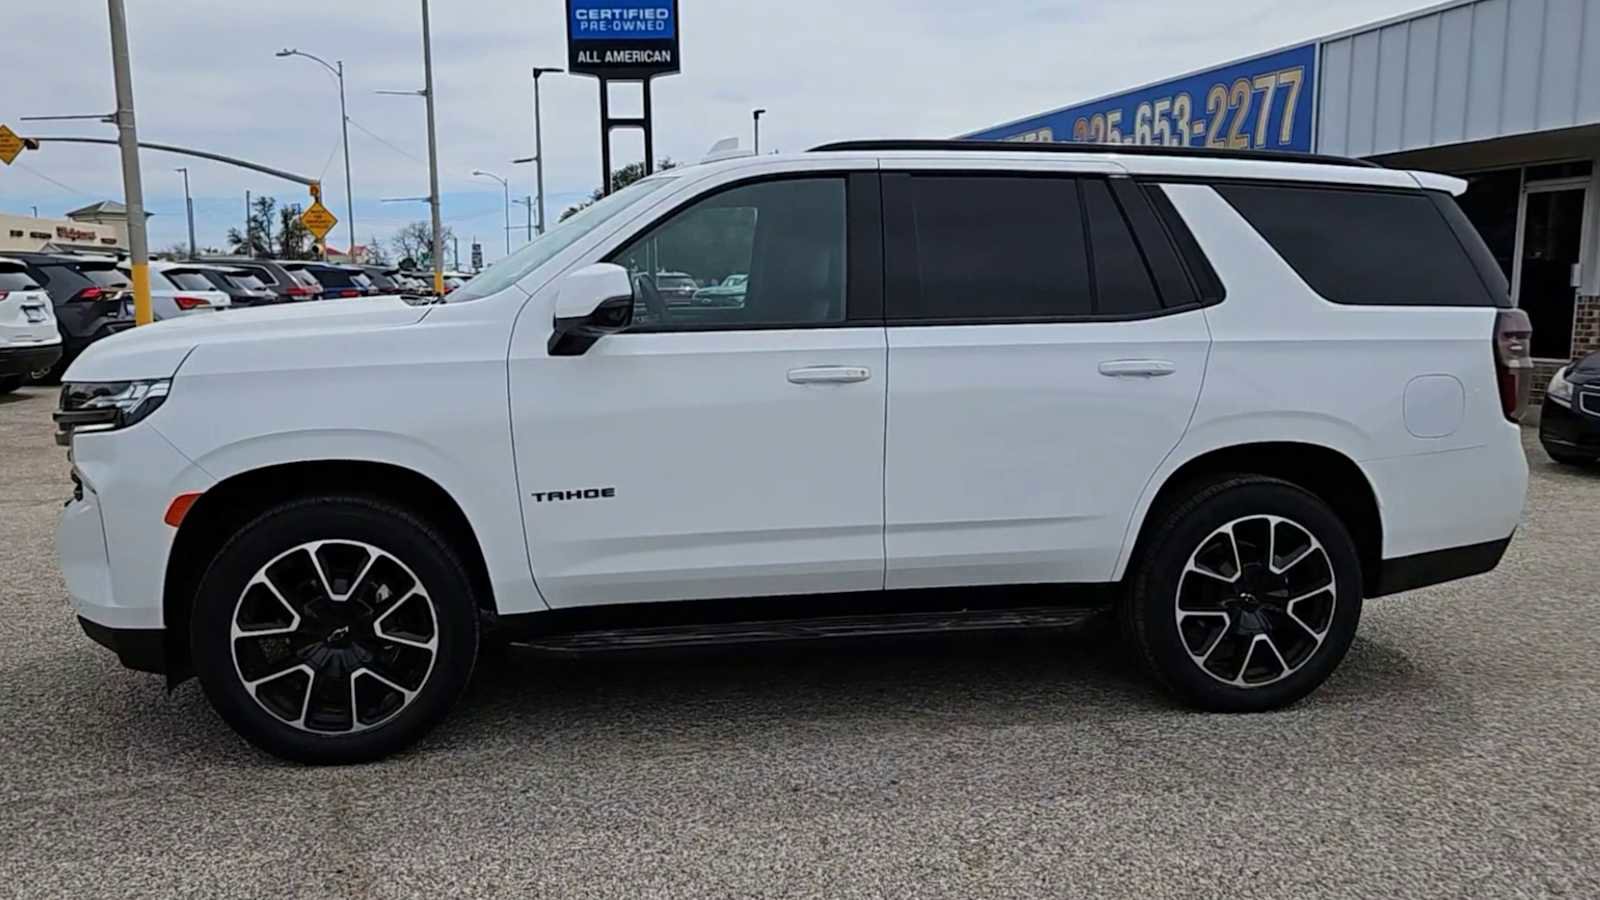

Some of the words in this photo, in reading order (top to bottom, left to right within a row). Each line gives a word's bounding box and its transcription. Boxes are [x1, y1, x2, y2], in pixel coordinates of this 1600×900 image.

[575, 8, 669, 20] CERTIFIED
[580, 20, 665, 31] PRE-OWNED
[577, 50, 602, 63] ALL
[604, 50, 671, 63] AMERICAN
[531, 488, 615, 502] TAHOE
